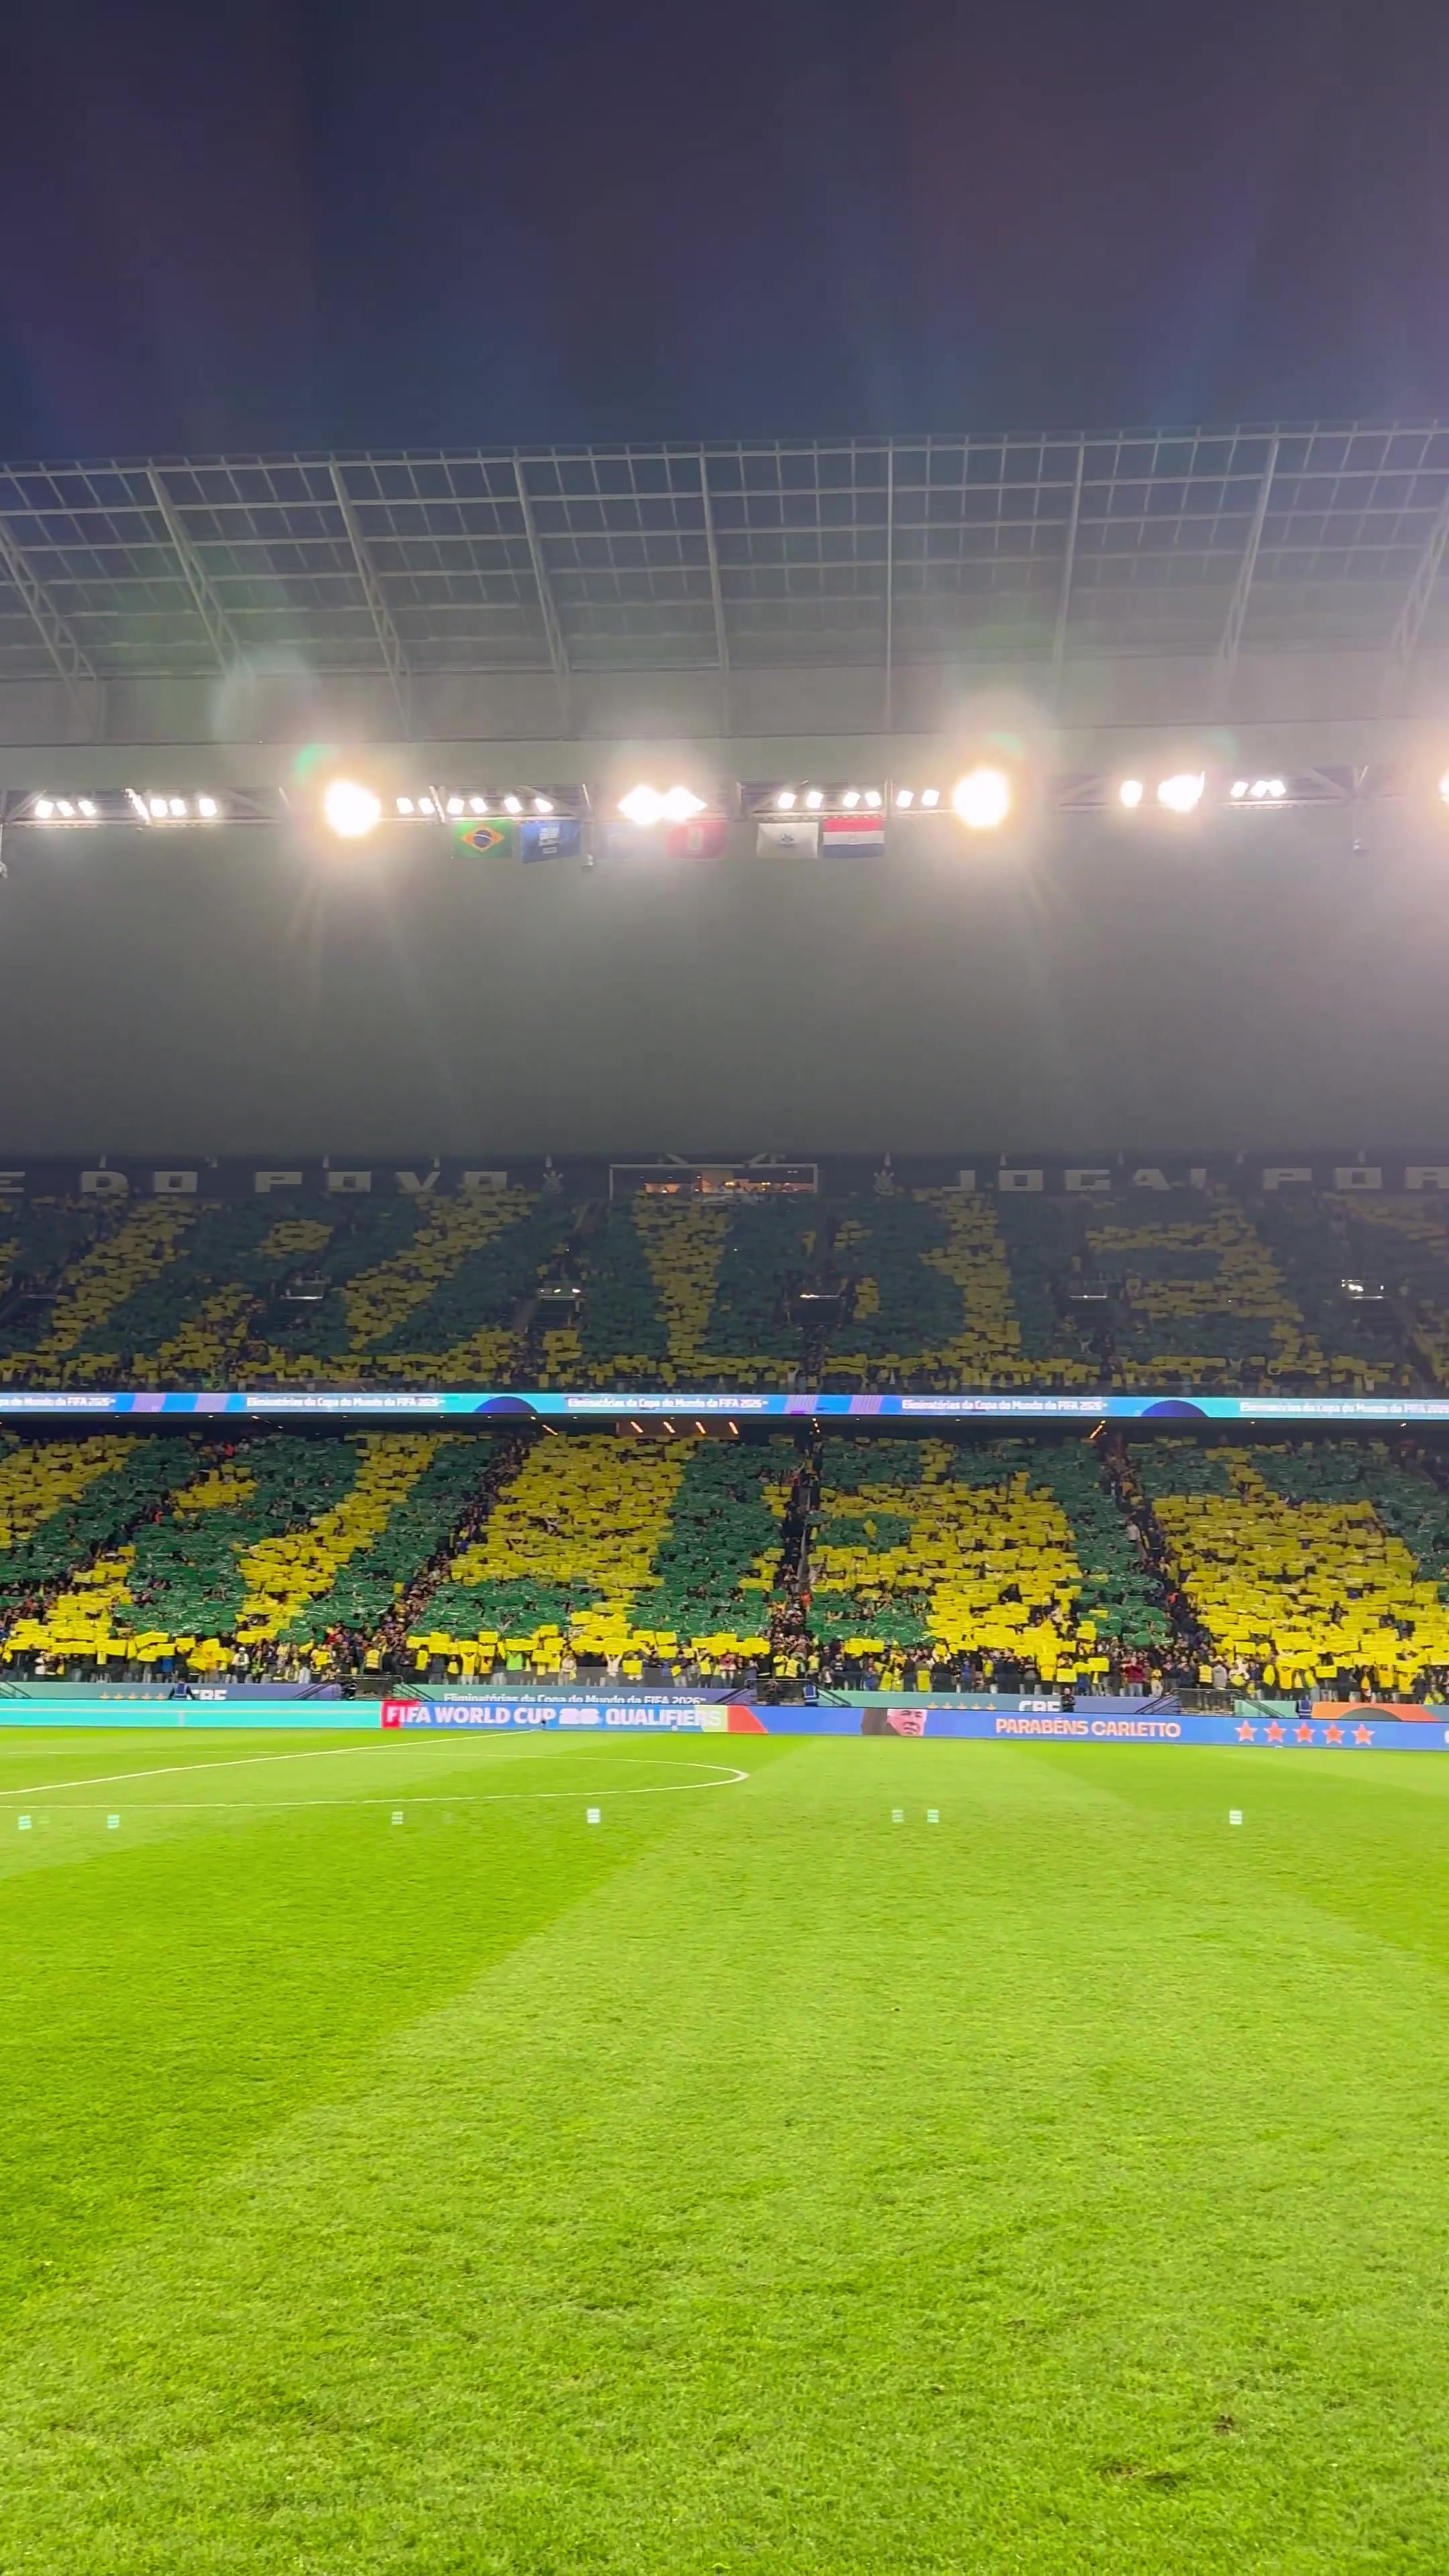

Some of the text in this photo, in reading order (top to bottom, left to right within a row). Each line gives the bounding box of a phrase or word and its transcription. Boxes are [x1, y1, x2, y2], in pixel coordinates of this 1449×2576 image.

[80, 1171, 199, 1193] DO
[254, 1171, 508, 1193] POVO
[1263, 1167, 1449, 1191] POR
[718, 1399, 739, 1407] FIFA
[1057, 1401, 1079, 1410] FIFA
[520, 1694, 536, 1702] da
[568, 1695, 584, 1703] do
[585, 1695, 625, 1703] Mundo
[627, 1695, 642, 1703] da
[644, 1696, 669, 1704] FIFA
[386, 1706, 432, 1723] FIFA
[434, 1707, 511, 1724] WORLD
[514, 1707, 556, 1724] CUP
[605, 1708, 722, 1726] QUALIFIERS
[996, 1716, 1181, 1738] PARABÉNS CARLETTO
